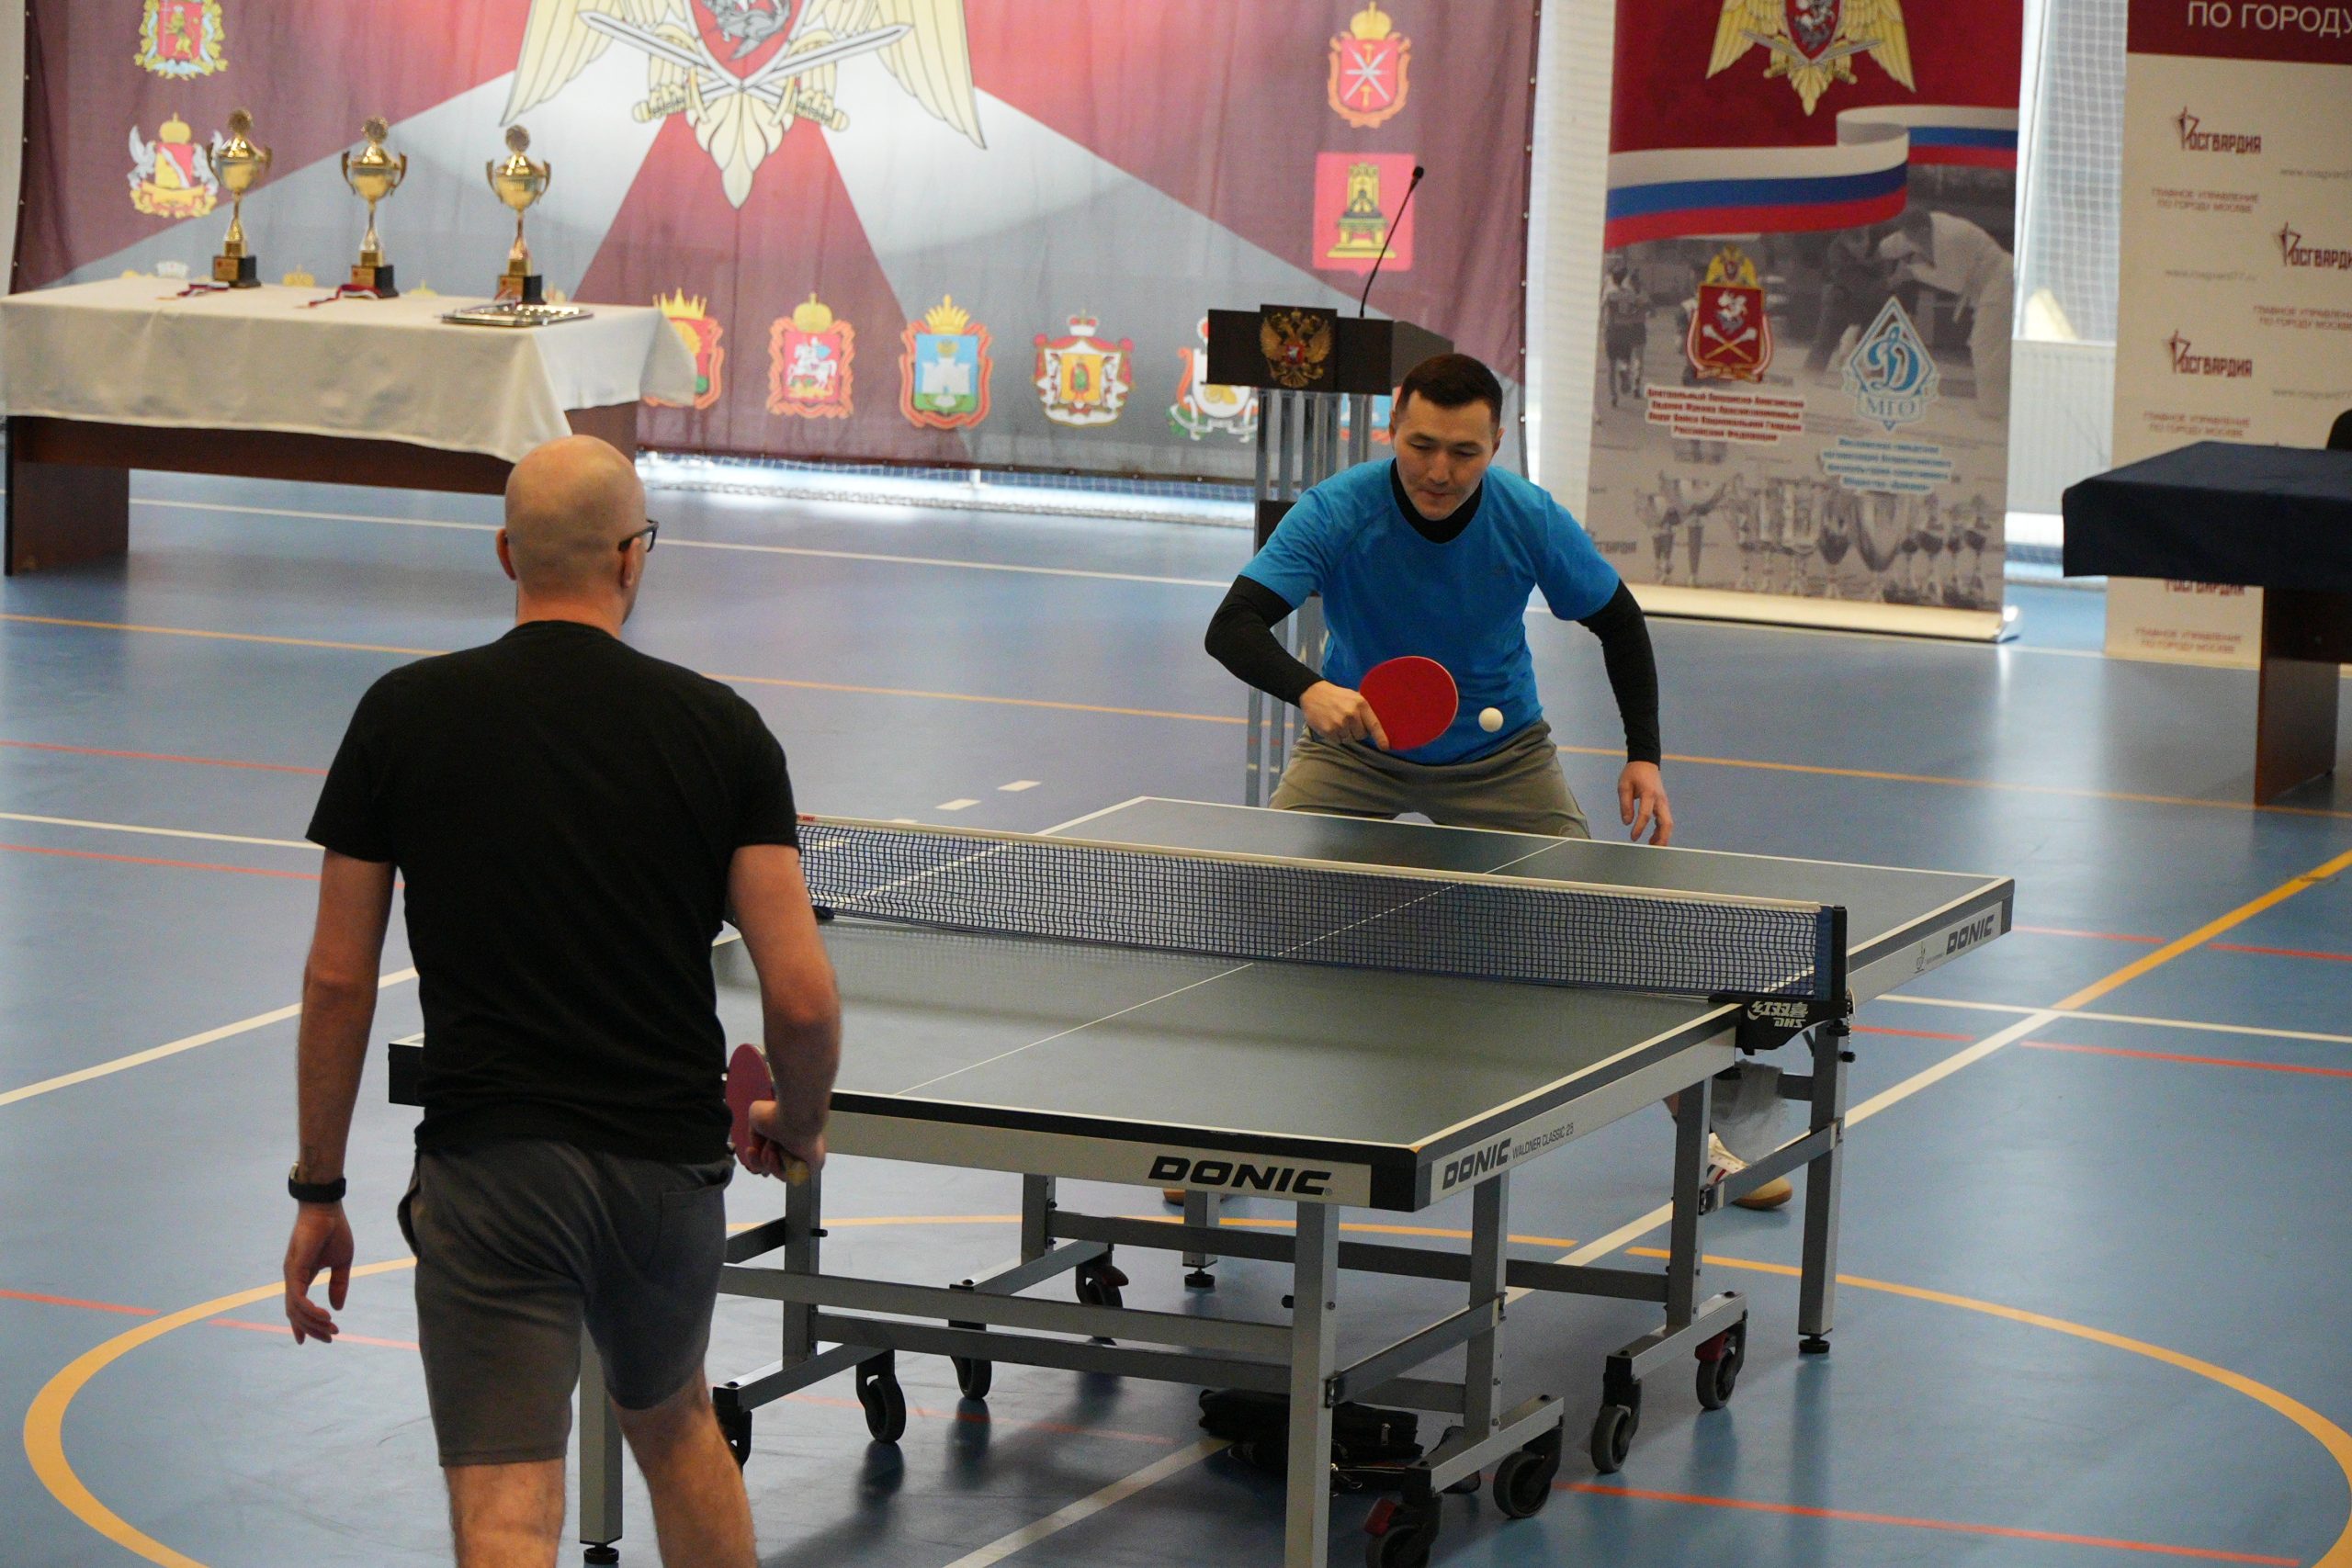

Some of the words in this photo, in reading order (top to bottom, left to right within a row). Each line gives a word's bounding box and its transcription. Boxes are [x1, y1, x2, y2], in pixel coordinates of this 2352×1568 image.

[2188, 1, 2232, 28] ПО
[1946, 914, 1995, 955] DONIC
[1773, 1017, 1806, 1028] DHS
[1148, 1155, 1331, 1195] DONIC
[1442, 1137, 1511, 1190] DONIC
[1512, 1136, 1541, 1159] WALDNER
[1543, 1125, 1566, 1146] CLASSIC
